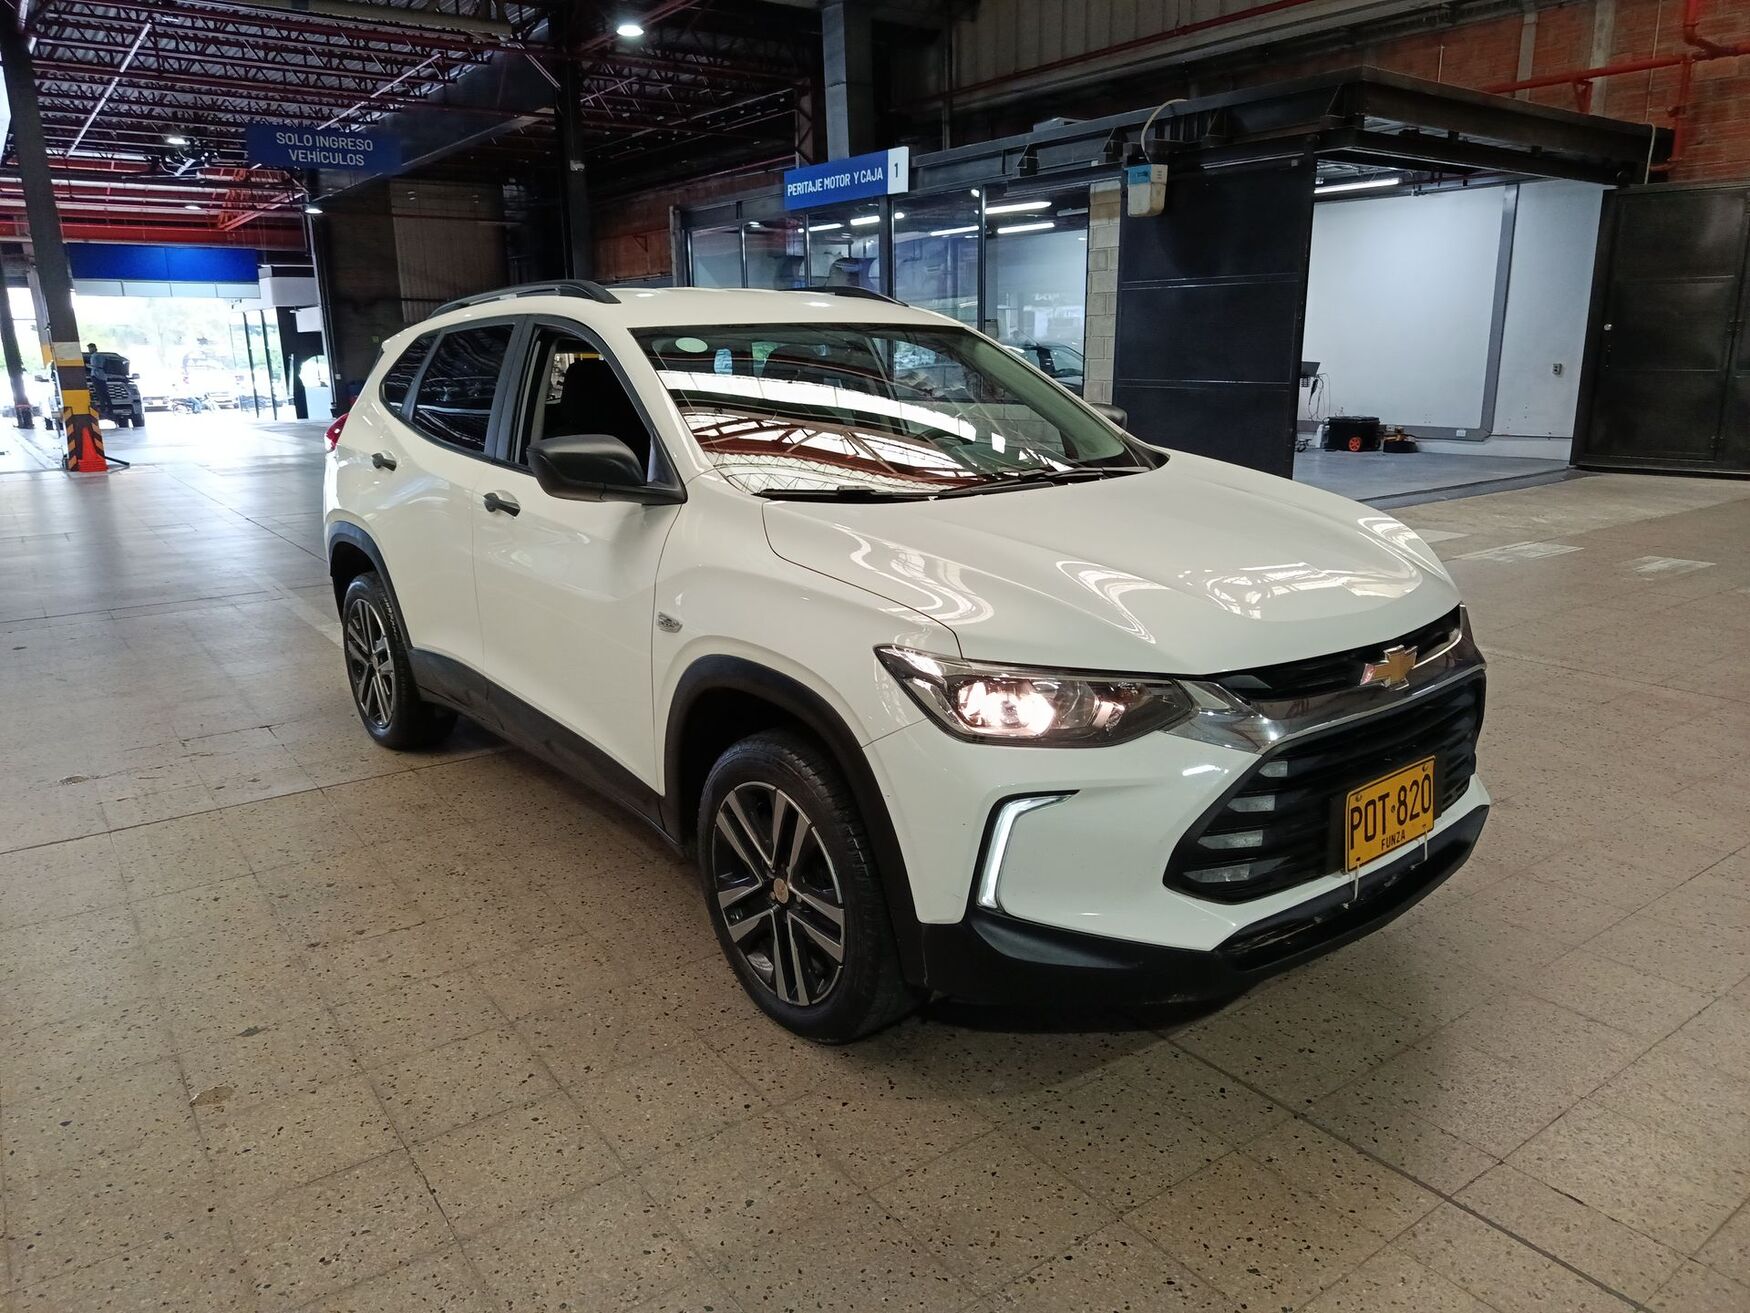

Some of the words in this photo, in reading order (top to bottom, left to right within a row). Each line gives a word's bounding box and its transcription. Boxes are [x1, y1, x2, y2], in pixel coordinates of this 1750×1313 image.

[276, 132, 312, 147] SOLO
[316, 135, 373, 151] INGRESO
[288, 149, 365, 166] VEHÍCULOS
[894, 162, 899, 178] 1
[787, 179, 823, 197] PERITAJE
[823, 173, 851, 191] MOTOR
[853, 171, 860, 184] Y
[860, 167, 883, 184] CAJA
[1381, 829, 1406, 851] FUNZA
